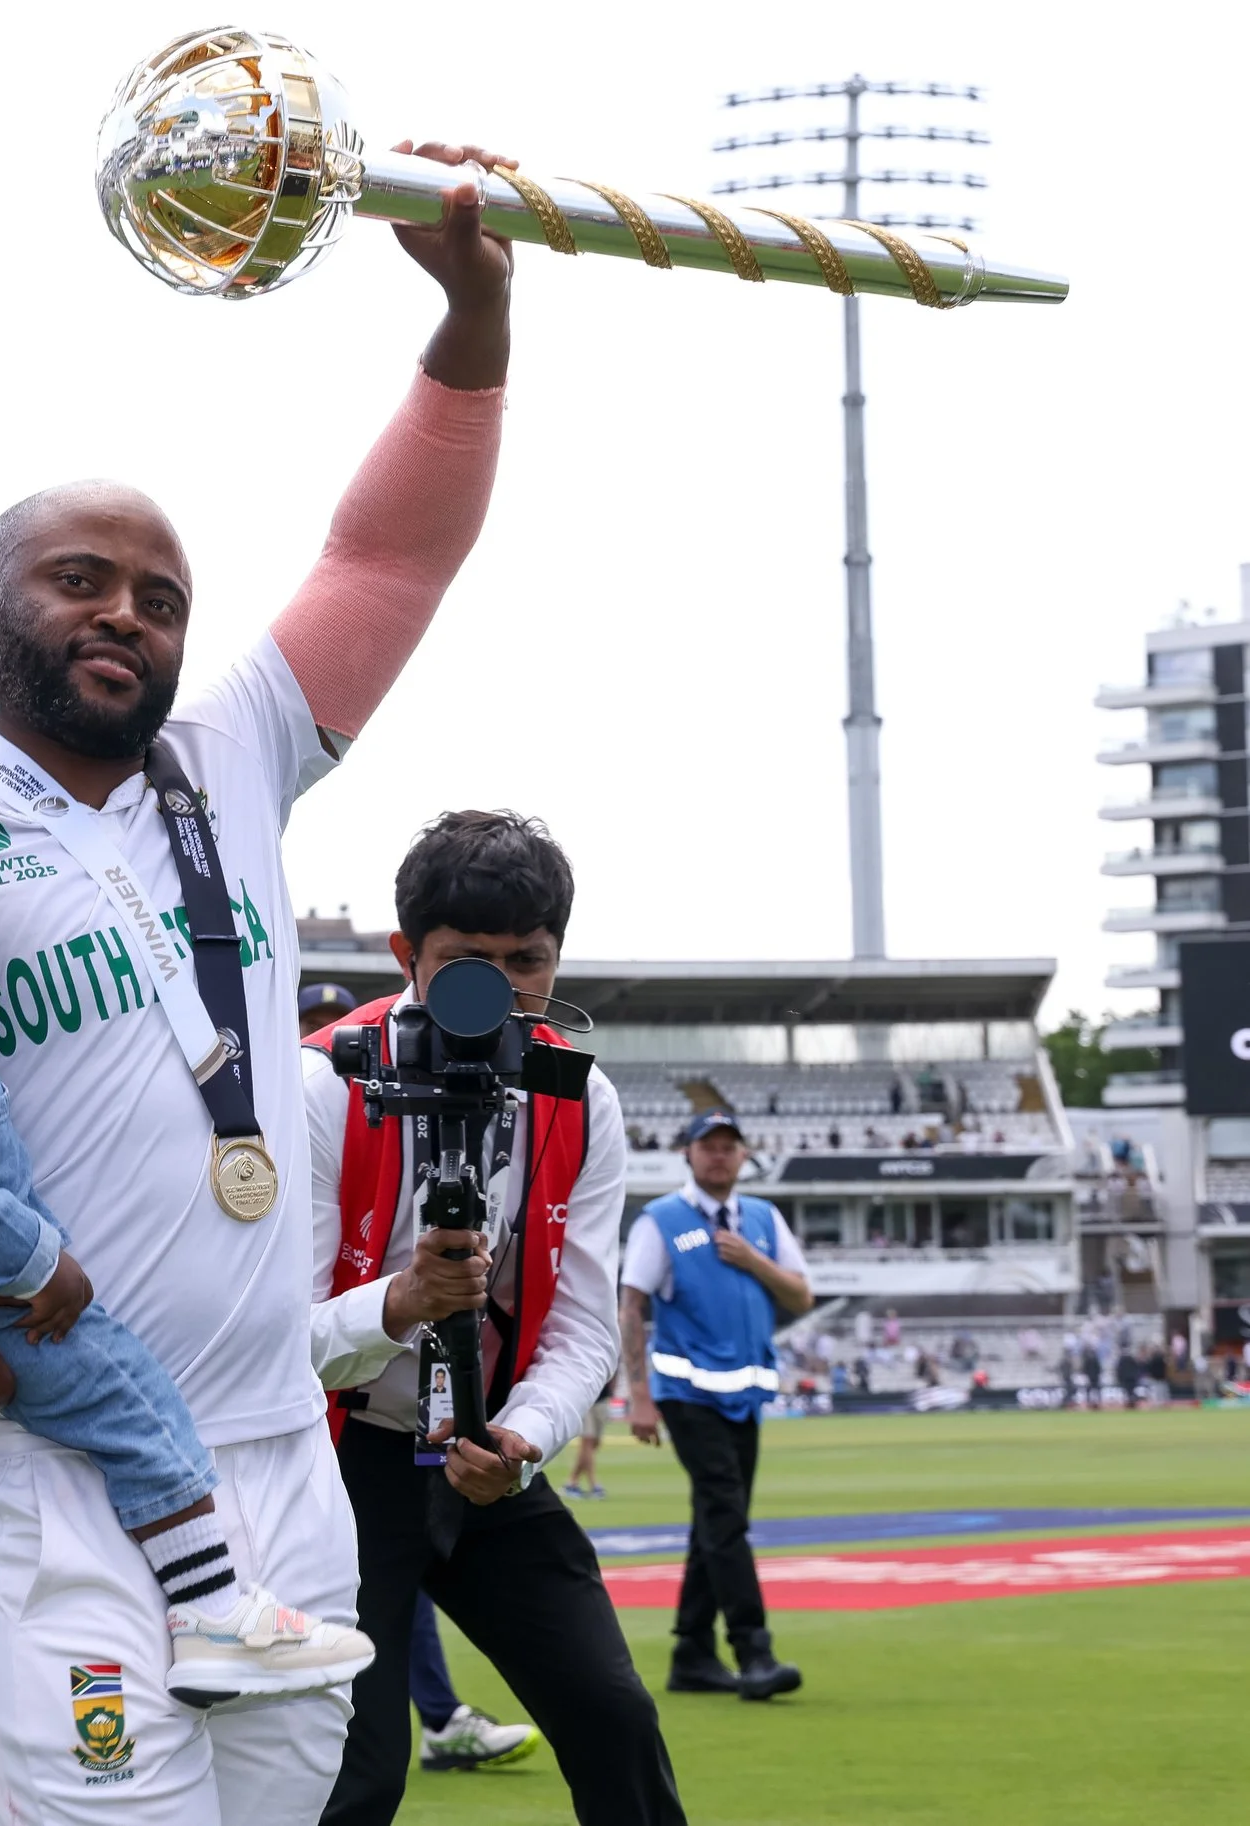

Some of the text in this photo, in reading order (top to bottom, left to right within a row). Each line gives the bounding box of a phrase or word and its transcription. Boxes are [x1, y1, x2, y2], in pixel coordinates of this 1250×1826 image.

[0, 764, 40, 797] CHAMPIONSHIP
[2, 777, 22, 794] WORLD
[28, 775, 47, 793] FINAL
[21, 790, 34, 801] ICC
[175, 816, 185, 838] FINAL
[182, 817, 202, 873] CHAMPIONSHIP
[189, 817, 211, 878] ICC WORLD TEST
[13, 865, 58, 882] 2025
[104, 865, 179, 983] WINNER
[417, 1114, 428, 1139] 202
[84, 1754, 131, 1770] SOUTH AFRICA
[85, 1770, 135, 1786] PROTEAS
